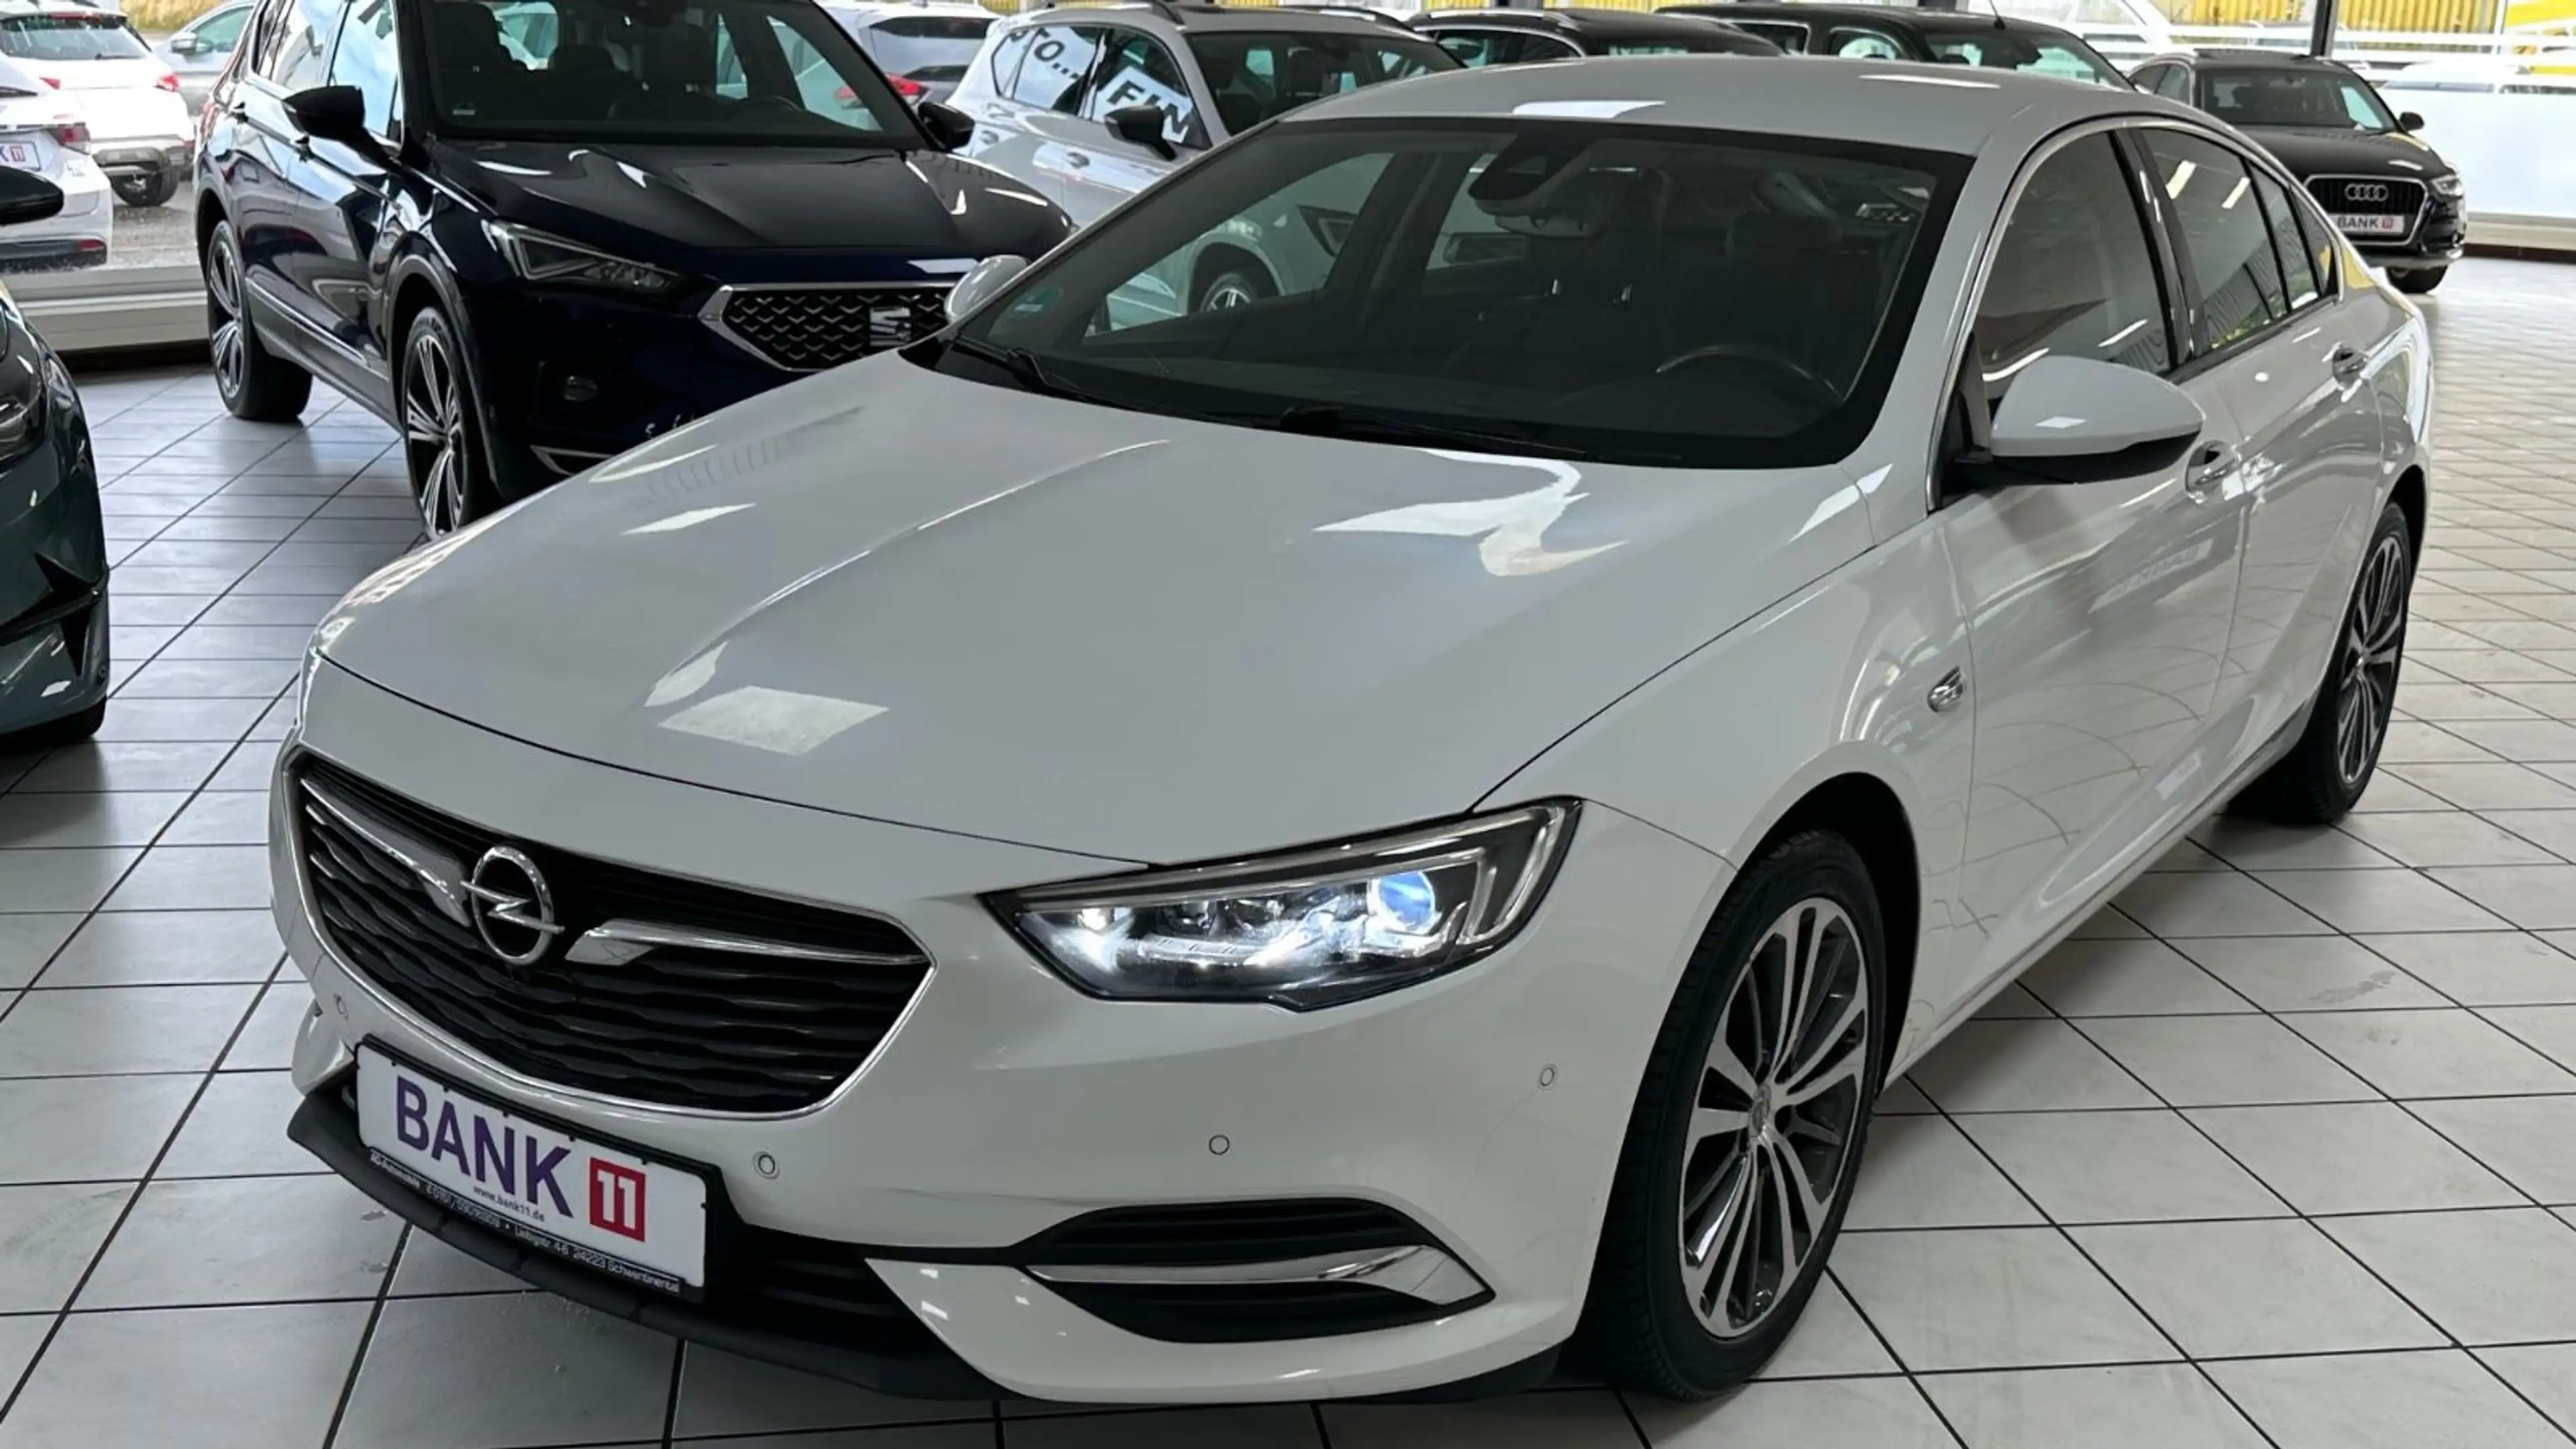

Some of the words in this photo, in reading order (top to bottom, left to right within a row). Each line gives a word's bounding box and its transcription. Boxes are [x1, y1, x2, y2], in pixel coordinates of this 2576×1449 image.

[396, 1075, 574, 1218] BANK
[594, 1166, 640, 1234] 11
[473, 1185, 545, 1222] www.bank11.de
